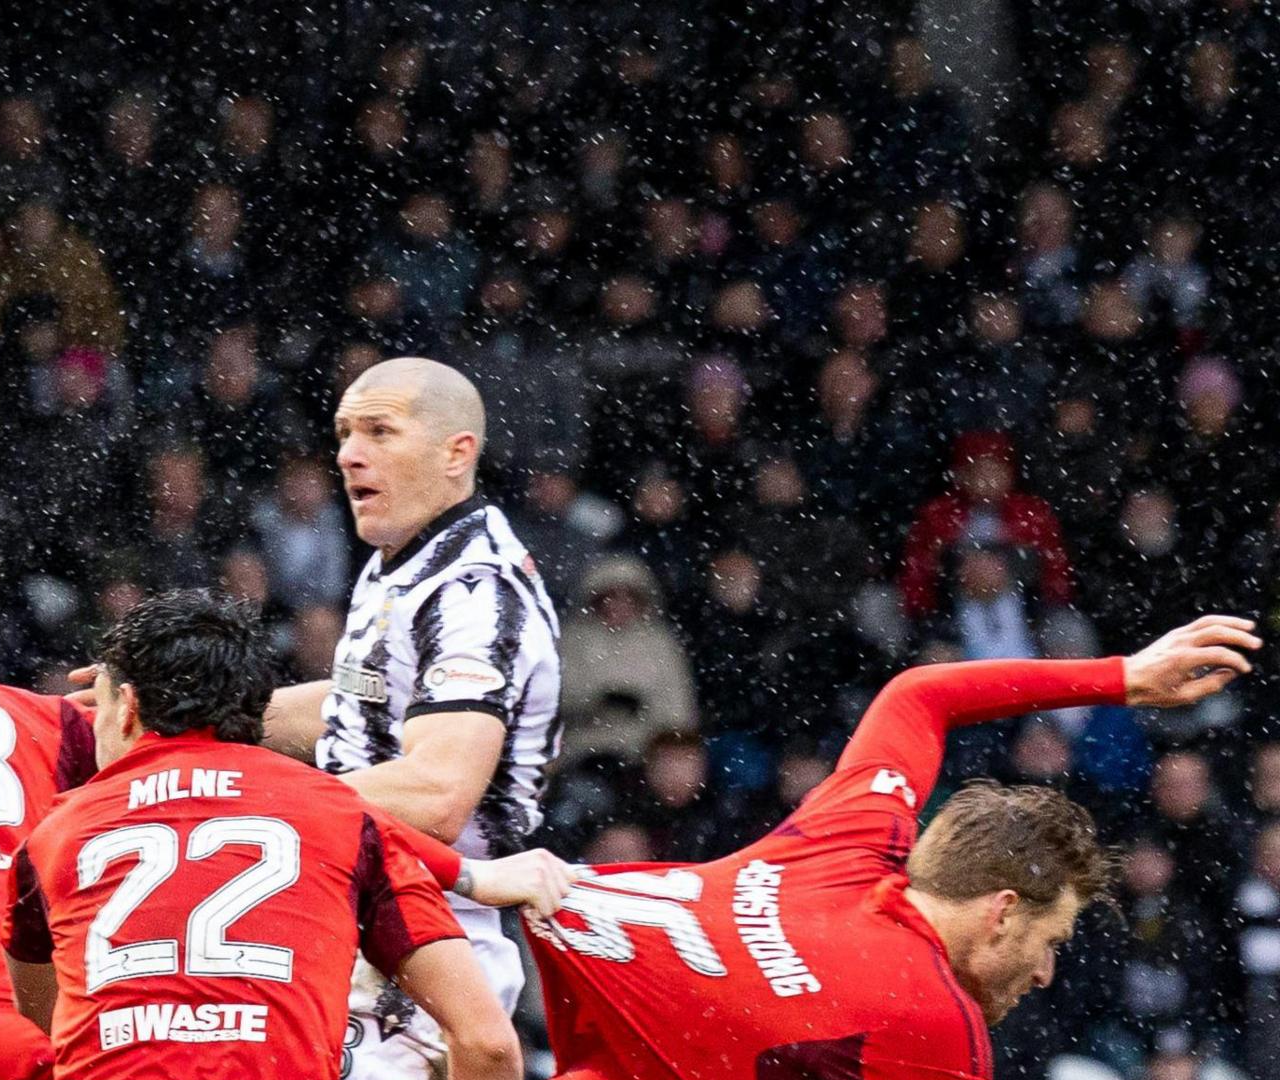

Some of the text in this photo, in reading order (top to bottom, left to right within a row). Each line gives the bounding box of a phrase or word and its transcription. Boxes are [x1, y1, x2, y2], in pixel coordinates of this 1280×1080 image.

[128, 768, 243, 809] MILNE
[77, 816, 301, 993] 22
[732, 860, 821, 996] ARMSTRONG
[133, 1003, 268, 1042] WASTE
